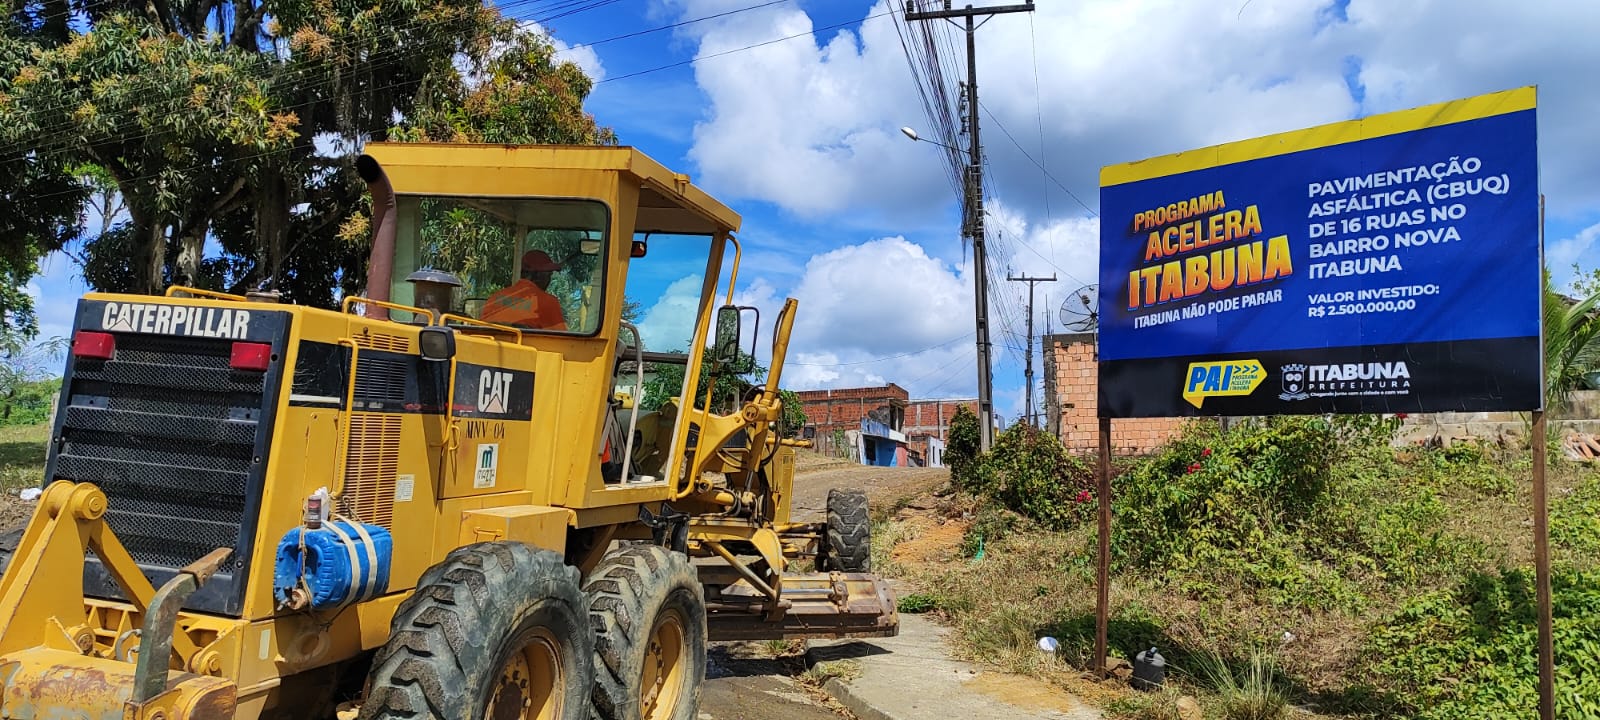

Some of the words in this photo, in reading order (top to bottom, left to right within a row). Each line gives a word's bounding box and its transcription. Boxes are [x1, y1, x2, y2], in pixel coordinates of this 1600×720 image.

[1308, 156, 1482, 197] PAVIMENTAÇÃO
[1134, 190, 1226, 232] PROGRAMA
[1308, 188, 1422, 218] ASFÁLTICA
[1426, 173, 1510, 204] (CBUQ)
[1144, 204, 1263, 262] ACELERA
[1309, 221, 1337, 238] DE
[1341, 217, 1362, 234] 16
[1366, 208, 1426, 231] RUAS
[1430, 203, 1467, 222] NO
[1309, 235, 1389, 258] BAIRRO
[1394, 226, 1461, 248] NOVA
[1128, 234, 1293, 310] ITABUNA
[1309, 254, 1402, 279] ITABUNA
[1134, 307, 1181, 329] ITABUNA
[1182, 302, 1206, 320] NÃO
[1208, 297, 1240, 315] PODE
[1241, 289, 1282, 309] PARAR
[1308, 289, 1354, 304] VALOR
[1357, 284, 1440, 301] INVESTIDO:
[1308, 305, 1326, 318] R$
[1327, 299, 1416, 316] 2.500.000,00
[102, 302, 250, 339] CATERPILLAR
[1188, 365, 1234, 392] PAI
[1308, 380, 1411, 390] PREFEITURA
[1309, 361, 1411, 382] ITABUNA
[477, 369, 513, 414] CAT
